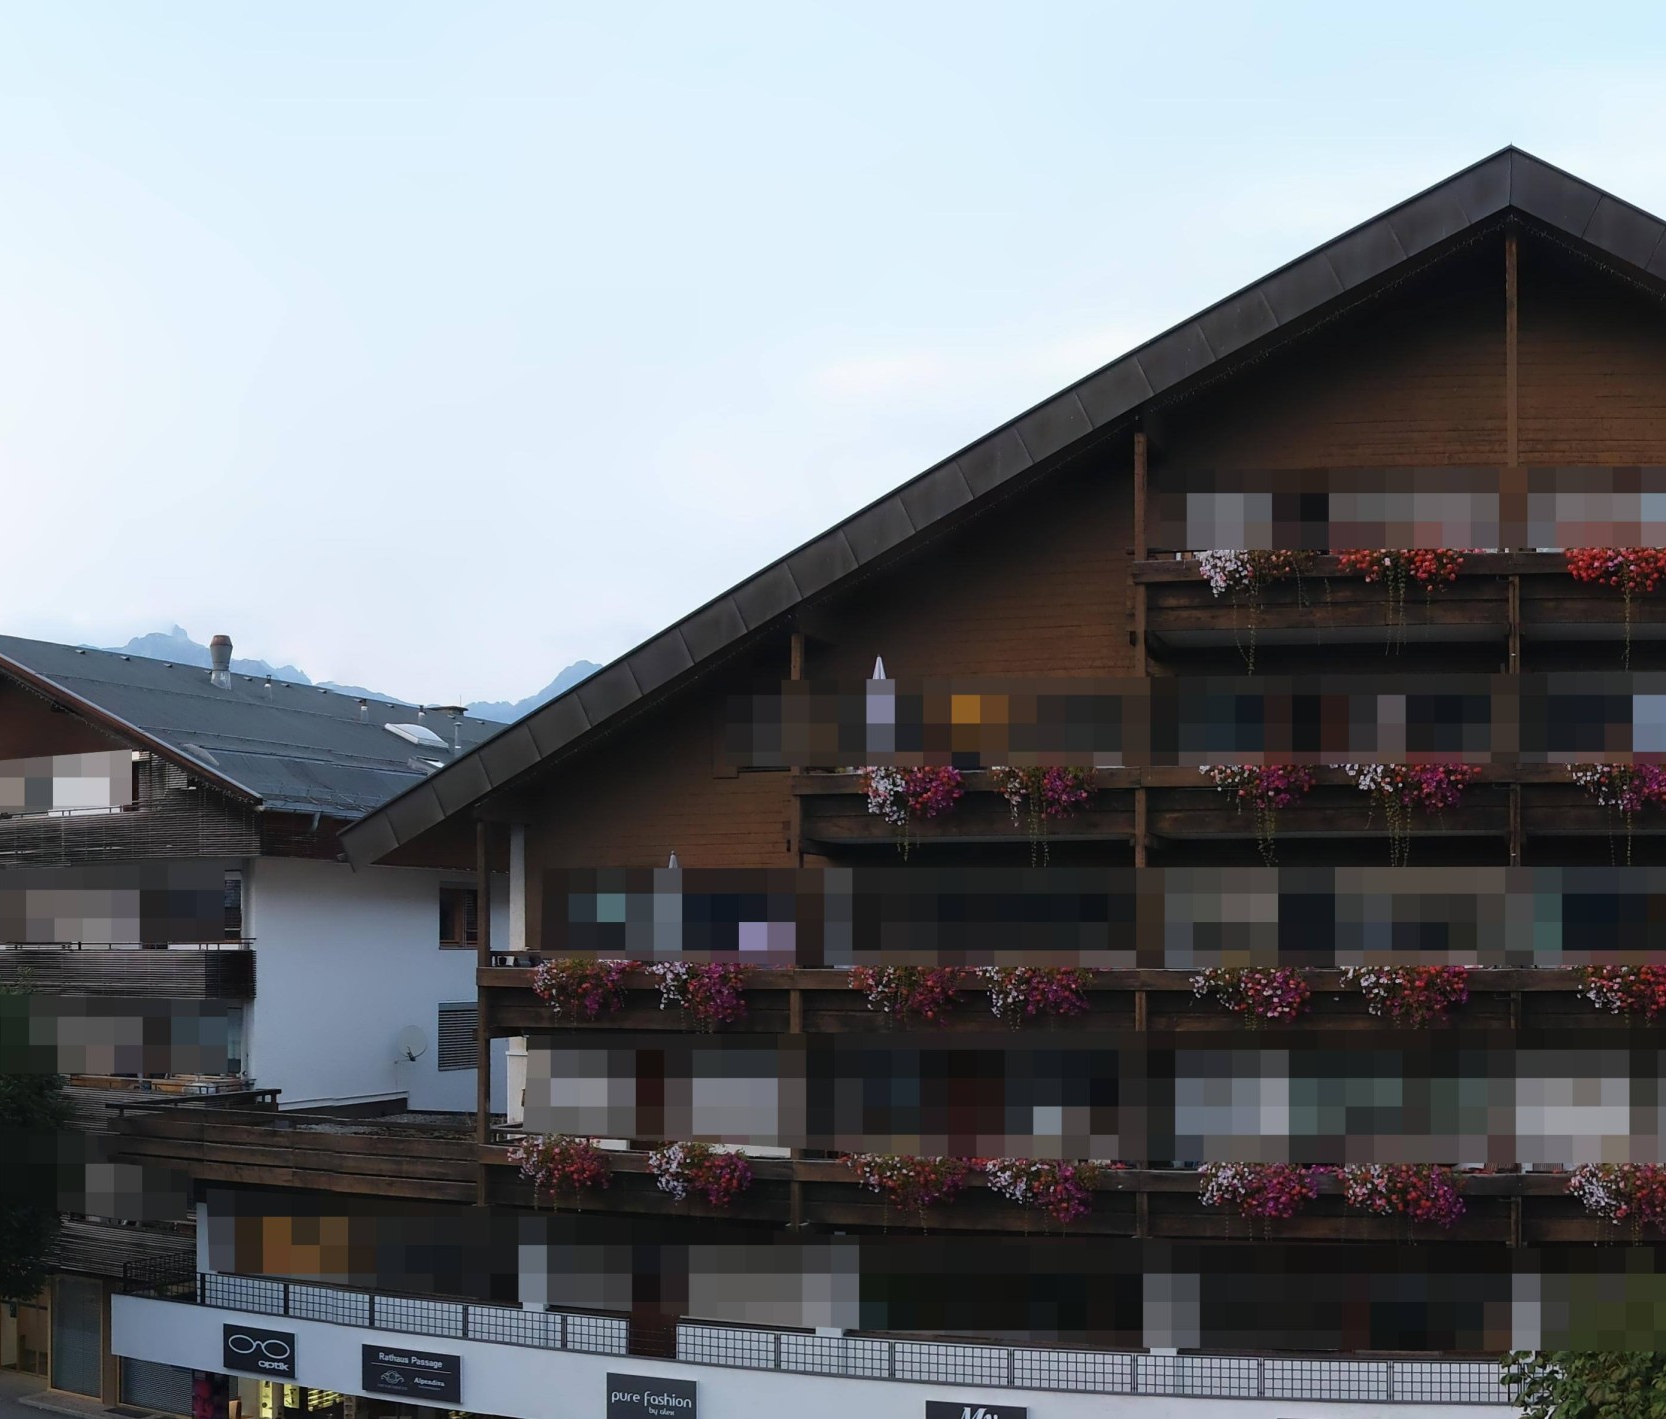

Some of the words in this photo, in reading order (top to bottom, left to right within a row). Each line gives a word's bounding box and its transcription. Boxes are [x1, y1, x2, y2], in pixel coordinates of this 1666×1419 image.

[258, 1360, 289, 1372] optik
[378, 1352, 409, 1364] Rathaus
[411, 1356, 443, 1369] Passage
[611, 1391, 641, 1405] pure
[644, 1391, 692, 1409] fashion
[648, 1406, 658, 1416] by
